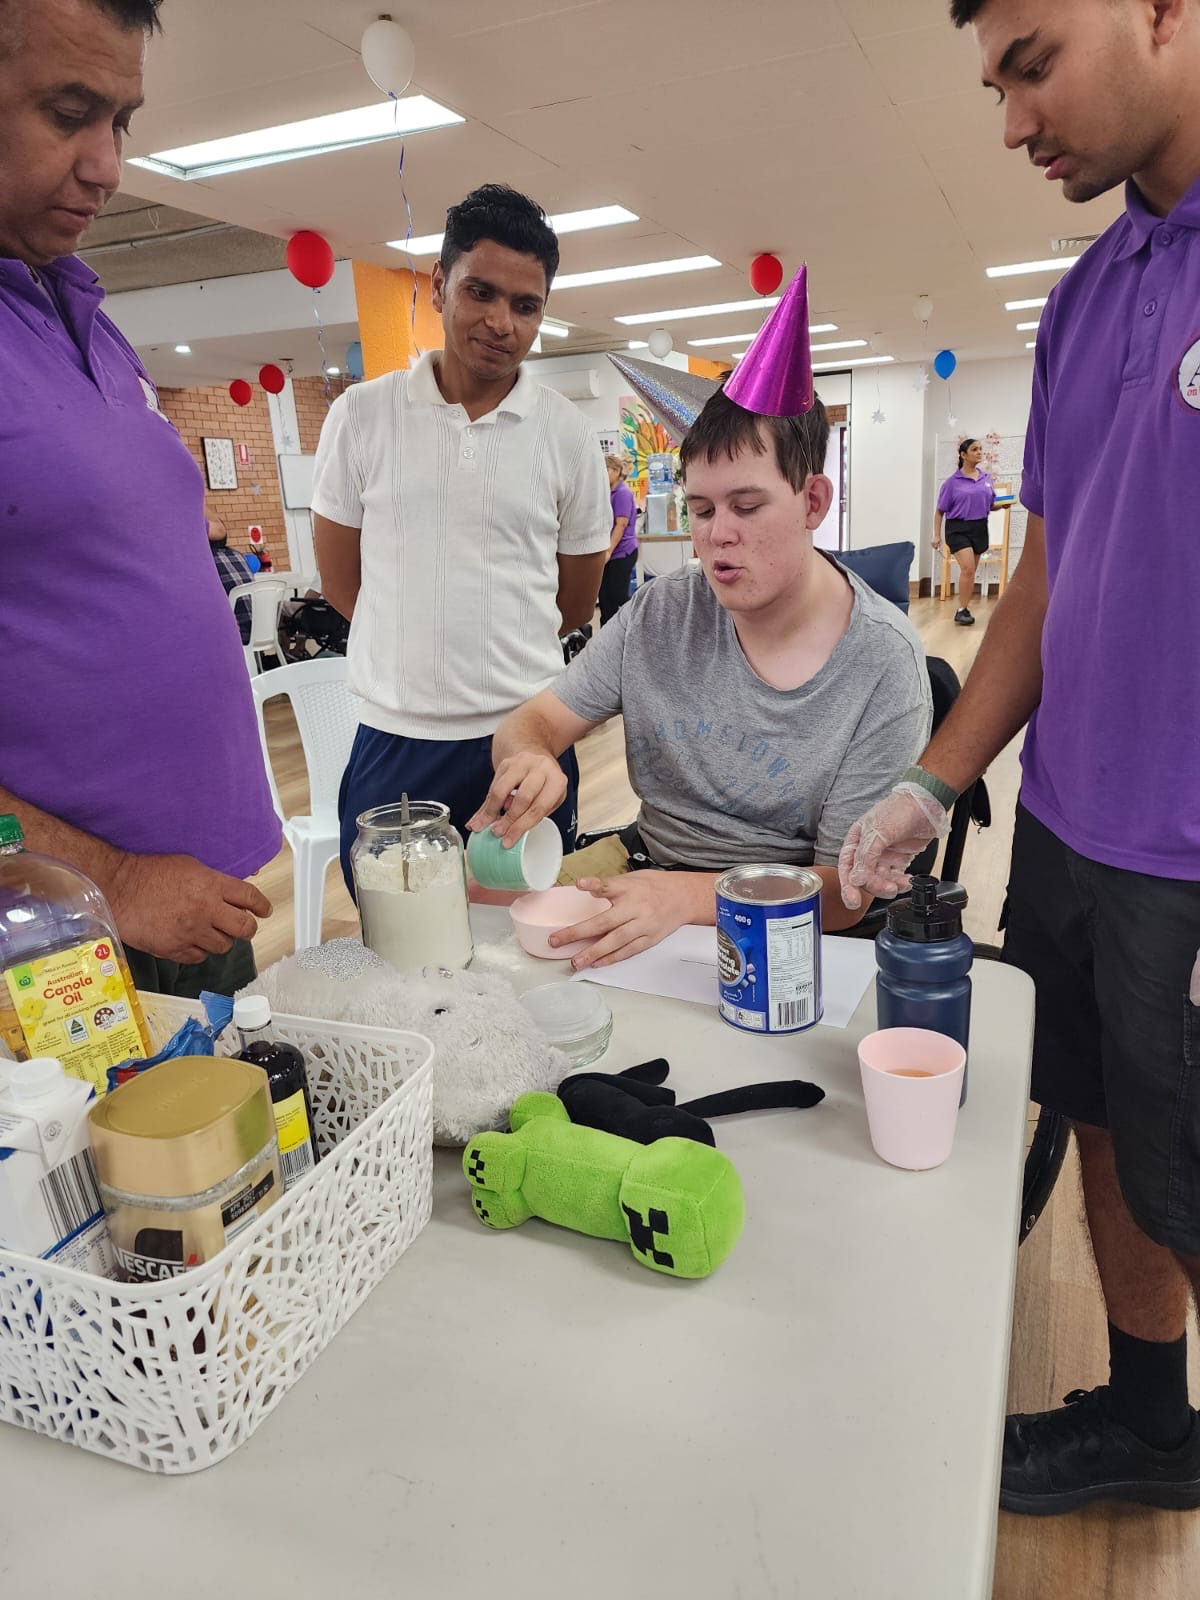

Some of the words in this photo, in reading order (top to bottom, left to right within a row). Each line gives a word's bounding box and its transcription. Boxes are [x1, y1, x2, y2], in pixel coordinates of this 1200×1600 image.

[97, 948, 109, 957] 2L
[47, 969, 84, 986] Australian
[43, 976, 93, 1000] Canola
[62, 992, 84, 1006] Oil
[112, 1243, 200, 1280] NESCAF
